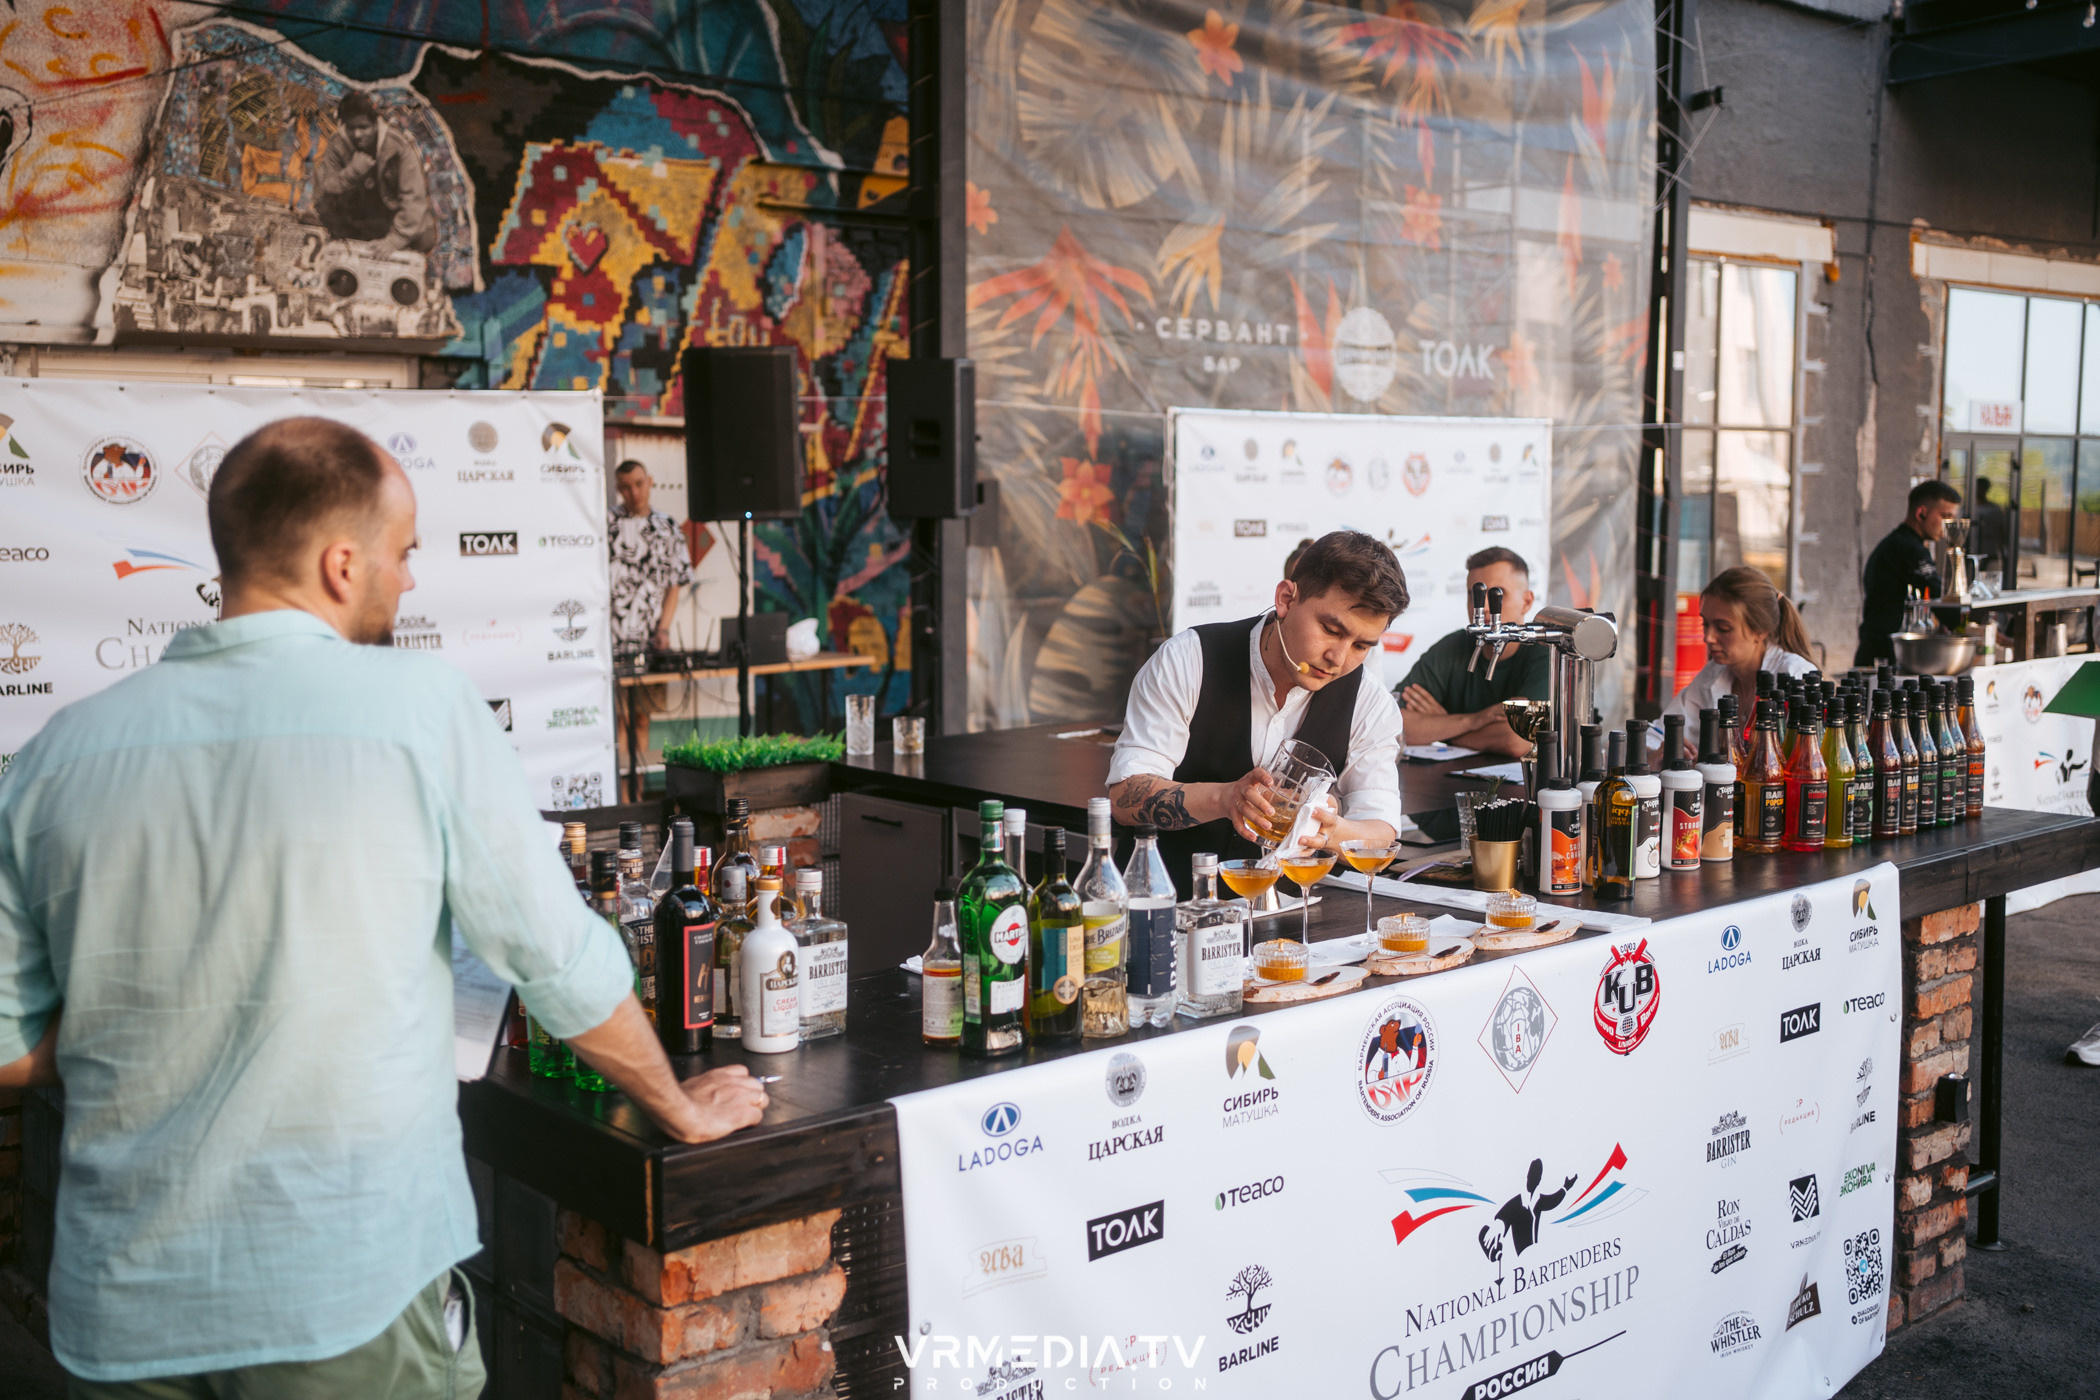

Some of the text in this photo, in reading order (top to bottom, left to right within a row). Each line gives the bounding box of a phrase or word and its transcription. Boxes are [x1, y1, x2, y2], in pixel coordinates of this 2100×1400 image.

[1155, 316, 1291, 345] СЕРВАНТ
[1203, 356, 1241, 373] БАР
[457, 470, 514, 482] ЦАРСКАЯ
[540, 463, 586, 474] СИБИРЬ
[394, 632, 443, 649] RRISTER
[547, 649, 595, 661] BARLINE
[1849, 925, 1878, 942] СИБИРЬ
[1201, 942, 1241, 960] BARRISTER
[1849, 938, 1880, 954] МАТУШКА
[809, 960, 848, 979] BARRISTER
[1708, 950, 1752, 974] LADOGA
[1782, 948, 1822, 971] ЦАРСКАЯ
[1603, 962, 1653, 1016] KUB
[1358, 1001, 1435, 1071] БАРМЕНСКАЯ АССОЦИАЦИЯ РОССИИ
[1223, 1087, 1279, 1112] СИБИРЬ
[1358, 1059, 1434, 1122] BARTENDERS ASSOCIATION OF RUSSIA
[1111, 1114, 1142, 1129] ВОДКА
[1222, 1103, 1279, 1129] МАТУШКА
[958, 1135, 1044, 1172] LADOGA
[1088, 1125, 1164, 1161] ЦАРСКАЯ
[1706, 1129, 1751, 1162] BARRISTER
[1721, 1155, 1737, 1169] GIN
[1844, 1161, 1876, 1184] EKONIVA
[1839, 1174, 1873, 1198] ЭКОНИВА
[1706, 1219, 1751, 1250] CALDAS
[1724, 1316, 1741, 1333] THE
[1711, 1324, 1762, 1354] WHISTLER
[1733, 1343, 1754, 1354] WHISKEY
[1218, 1336, 1280, 1373] BARLINE
[1473, 1356, 1549, 1400] РОССИЯ
